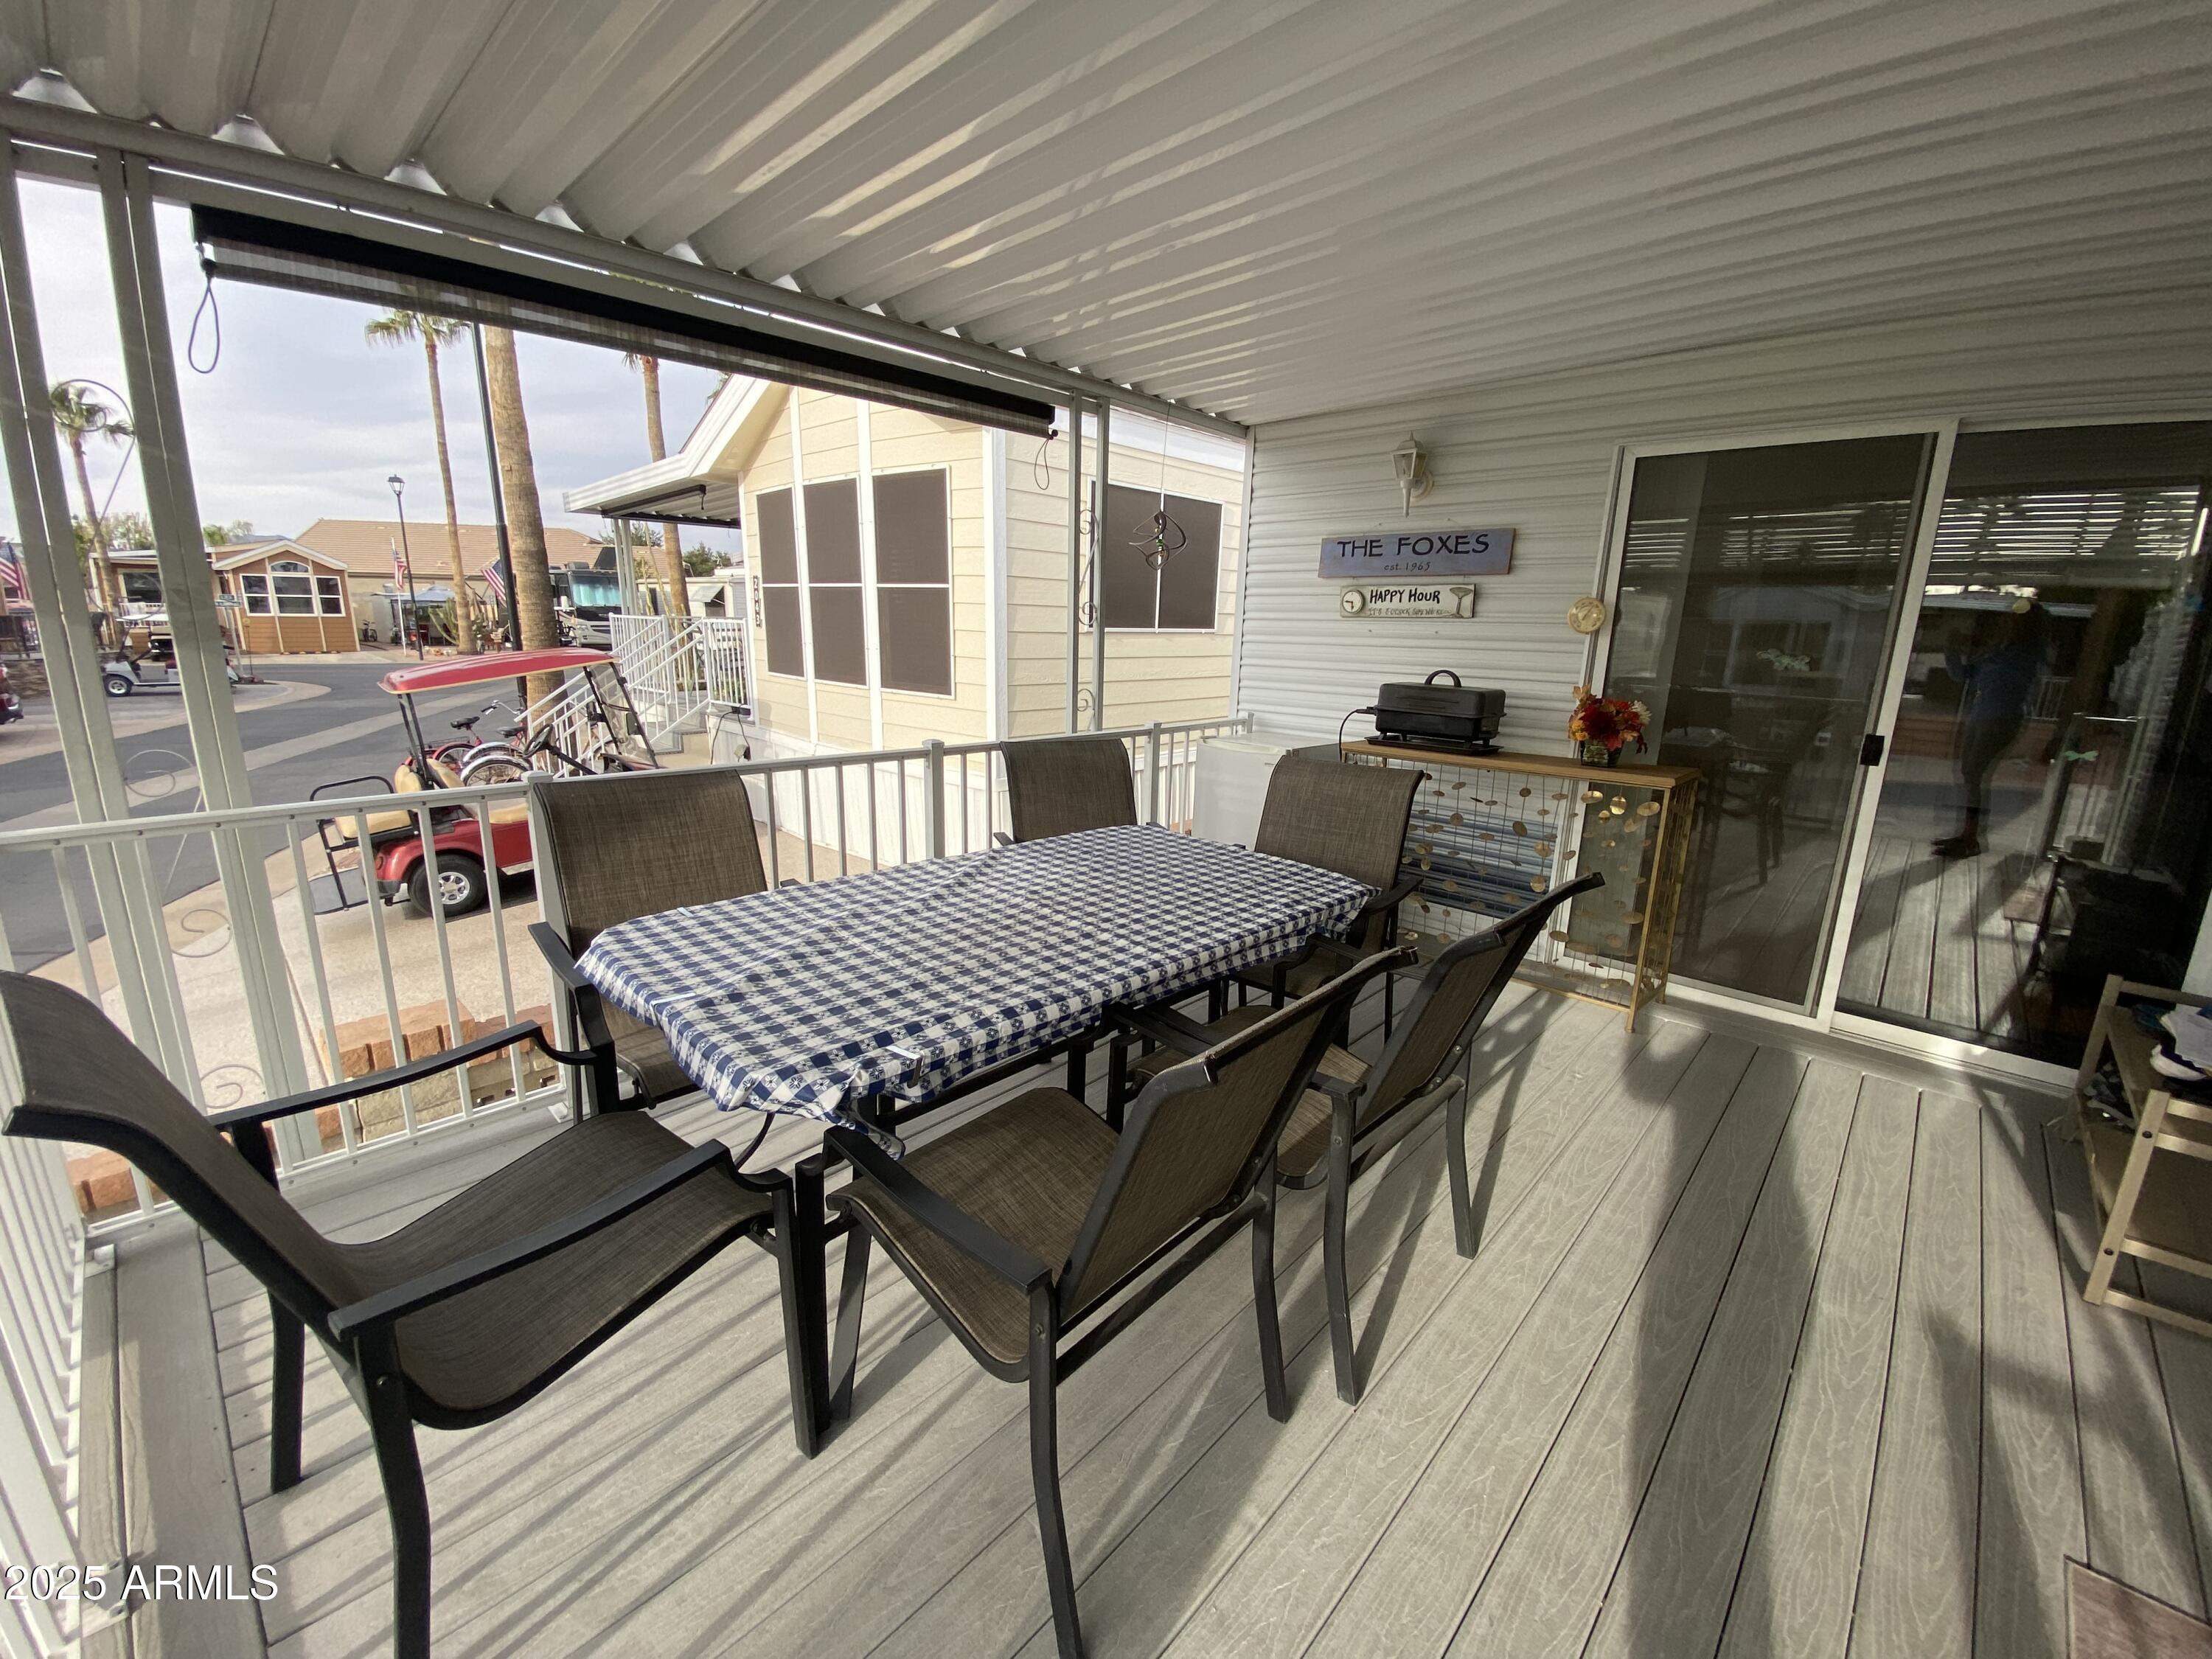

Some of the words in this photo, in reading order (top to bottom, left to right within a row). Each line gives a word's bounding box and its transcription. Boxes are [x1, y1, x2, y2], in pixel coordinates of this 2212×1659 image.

[1337, 539, 1383, 557] THE
[1397, 533, 1489, 556] FOXES
[1369, 588, 1405, 605] HAPPY
[1408, 588, 1441, 605] HOUR
